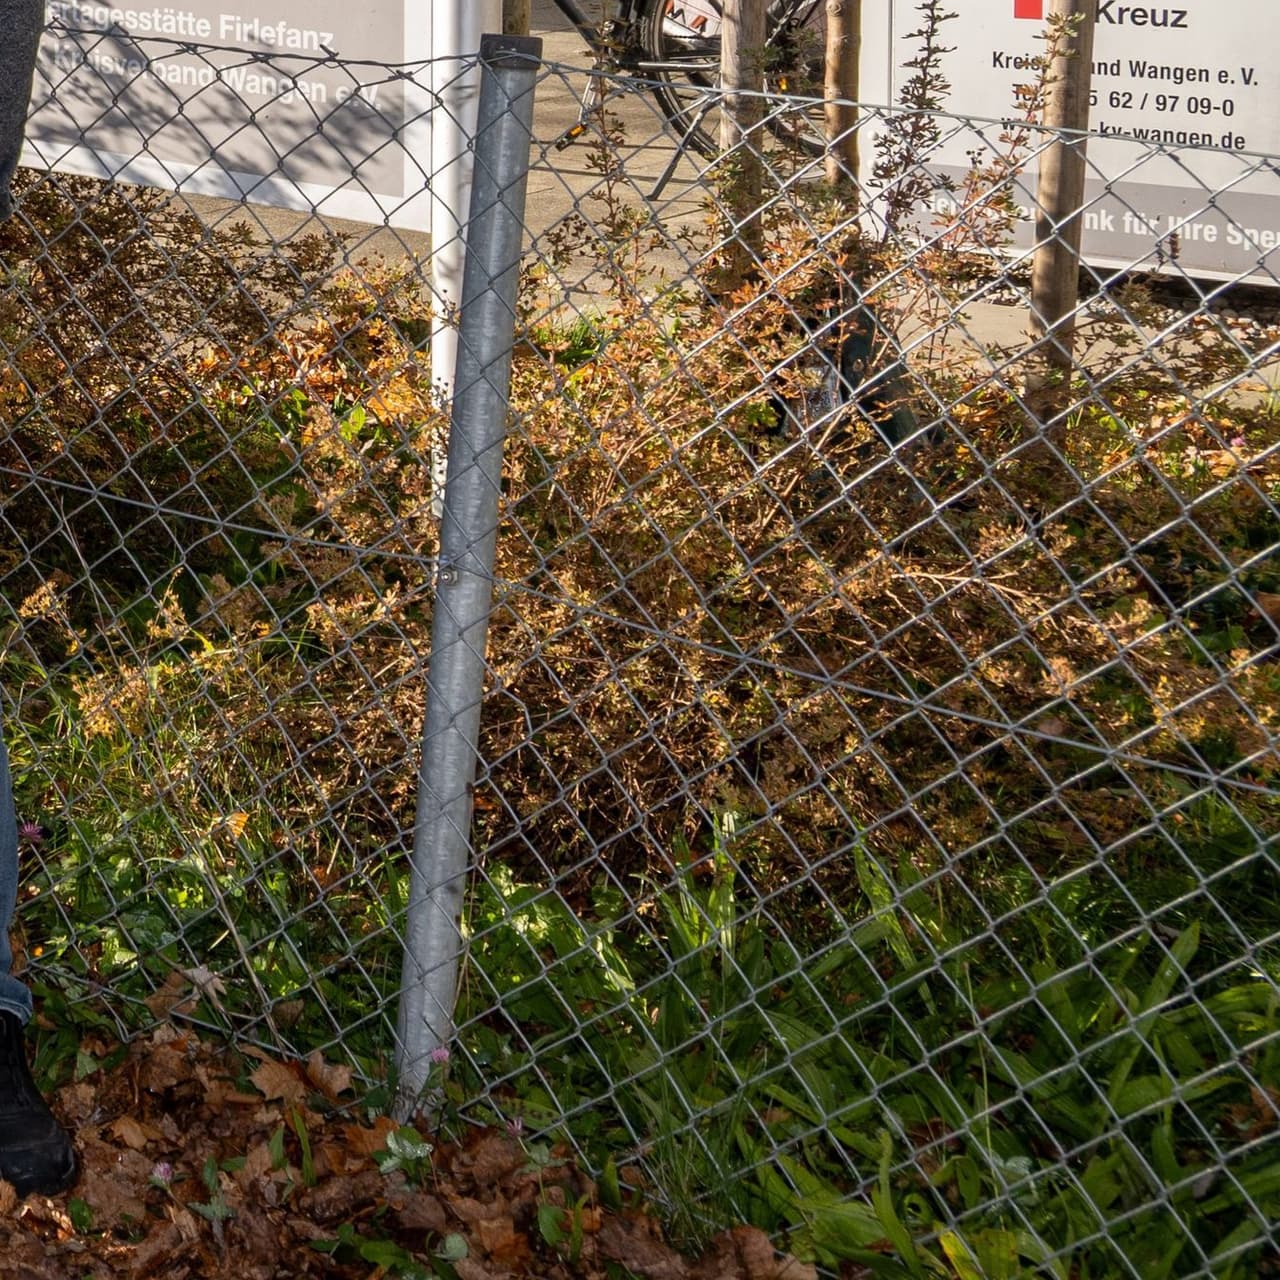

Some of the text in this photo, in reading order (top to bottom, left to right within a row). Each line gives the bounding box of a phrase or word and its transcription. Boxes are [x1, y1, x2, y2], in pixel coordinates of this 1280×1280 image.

[1095, 0, 1189, 28] Kreuz
[219, 13, 335, 51] Firlefanz
[223, 65, 328, 105] Wangen
[1128, 60, 1210, 85] Wangen
[1108, 91, 1133, 109] 62
[1155, 94, 1179, 112] 97
[1187, 96, 1235, 117] 09-0
[1122, 211, 1160, 237] für
[1168, 216, 1218, 243] Ihre
